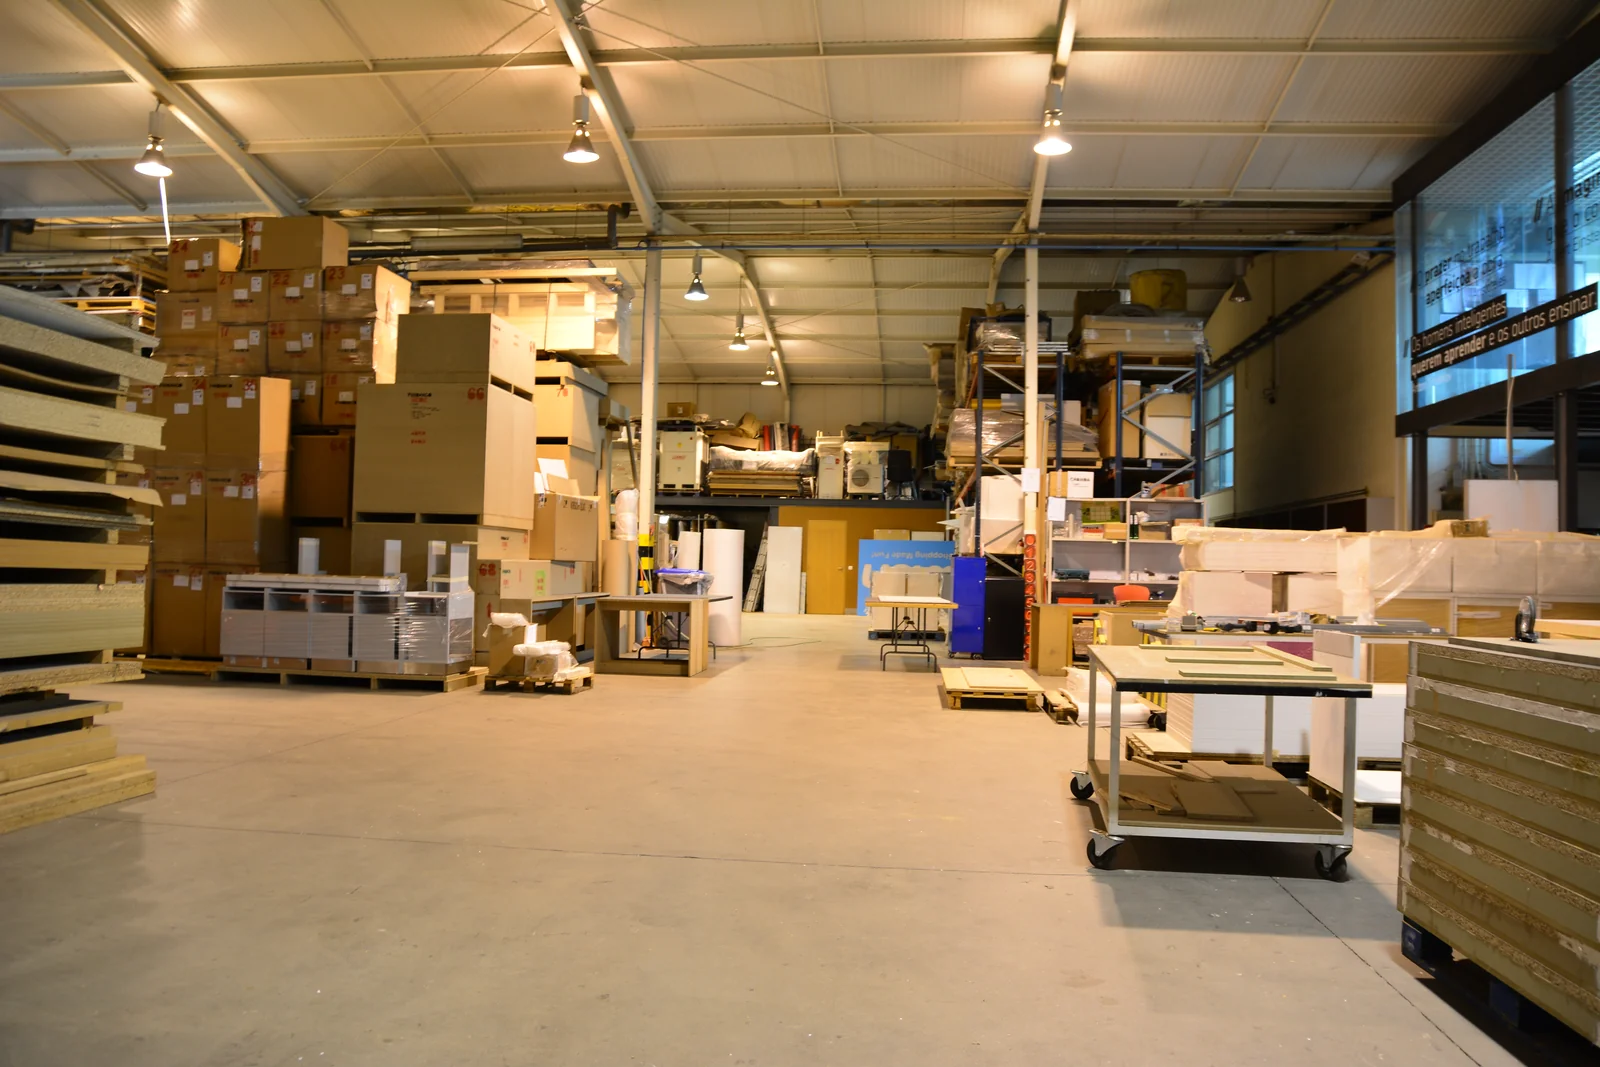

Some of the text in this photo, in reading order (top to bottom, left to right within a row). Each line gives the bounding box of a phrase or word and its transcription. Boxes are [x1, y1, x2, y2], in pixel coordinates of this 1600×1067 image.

[1422, 323, 1453, 348] homens
[1454, 300, 1507, 333] inteligentes
[1411, 353, 1442, 377] querem
[1444, 334, 1487, 364] aprender
[1489, 331, 1496, 346] e
[1497, 325, 1509, 343] os
[1511, 311, 1545, 338] outros
[467, 387, 485, 401] 66
[479, 562, 497, 577] 68
